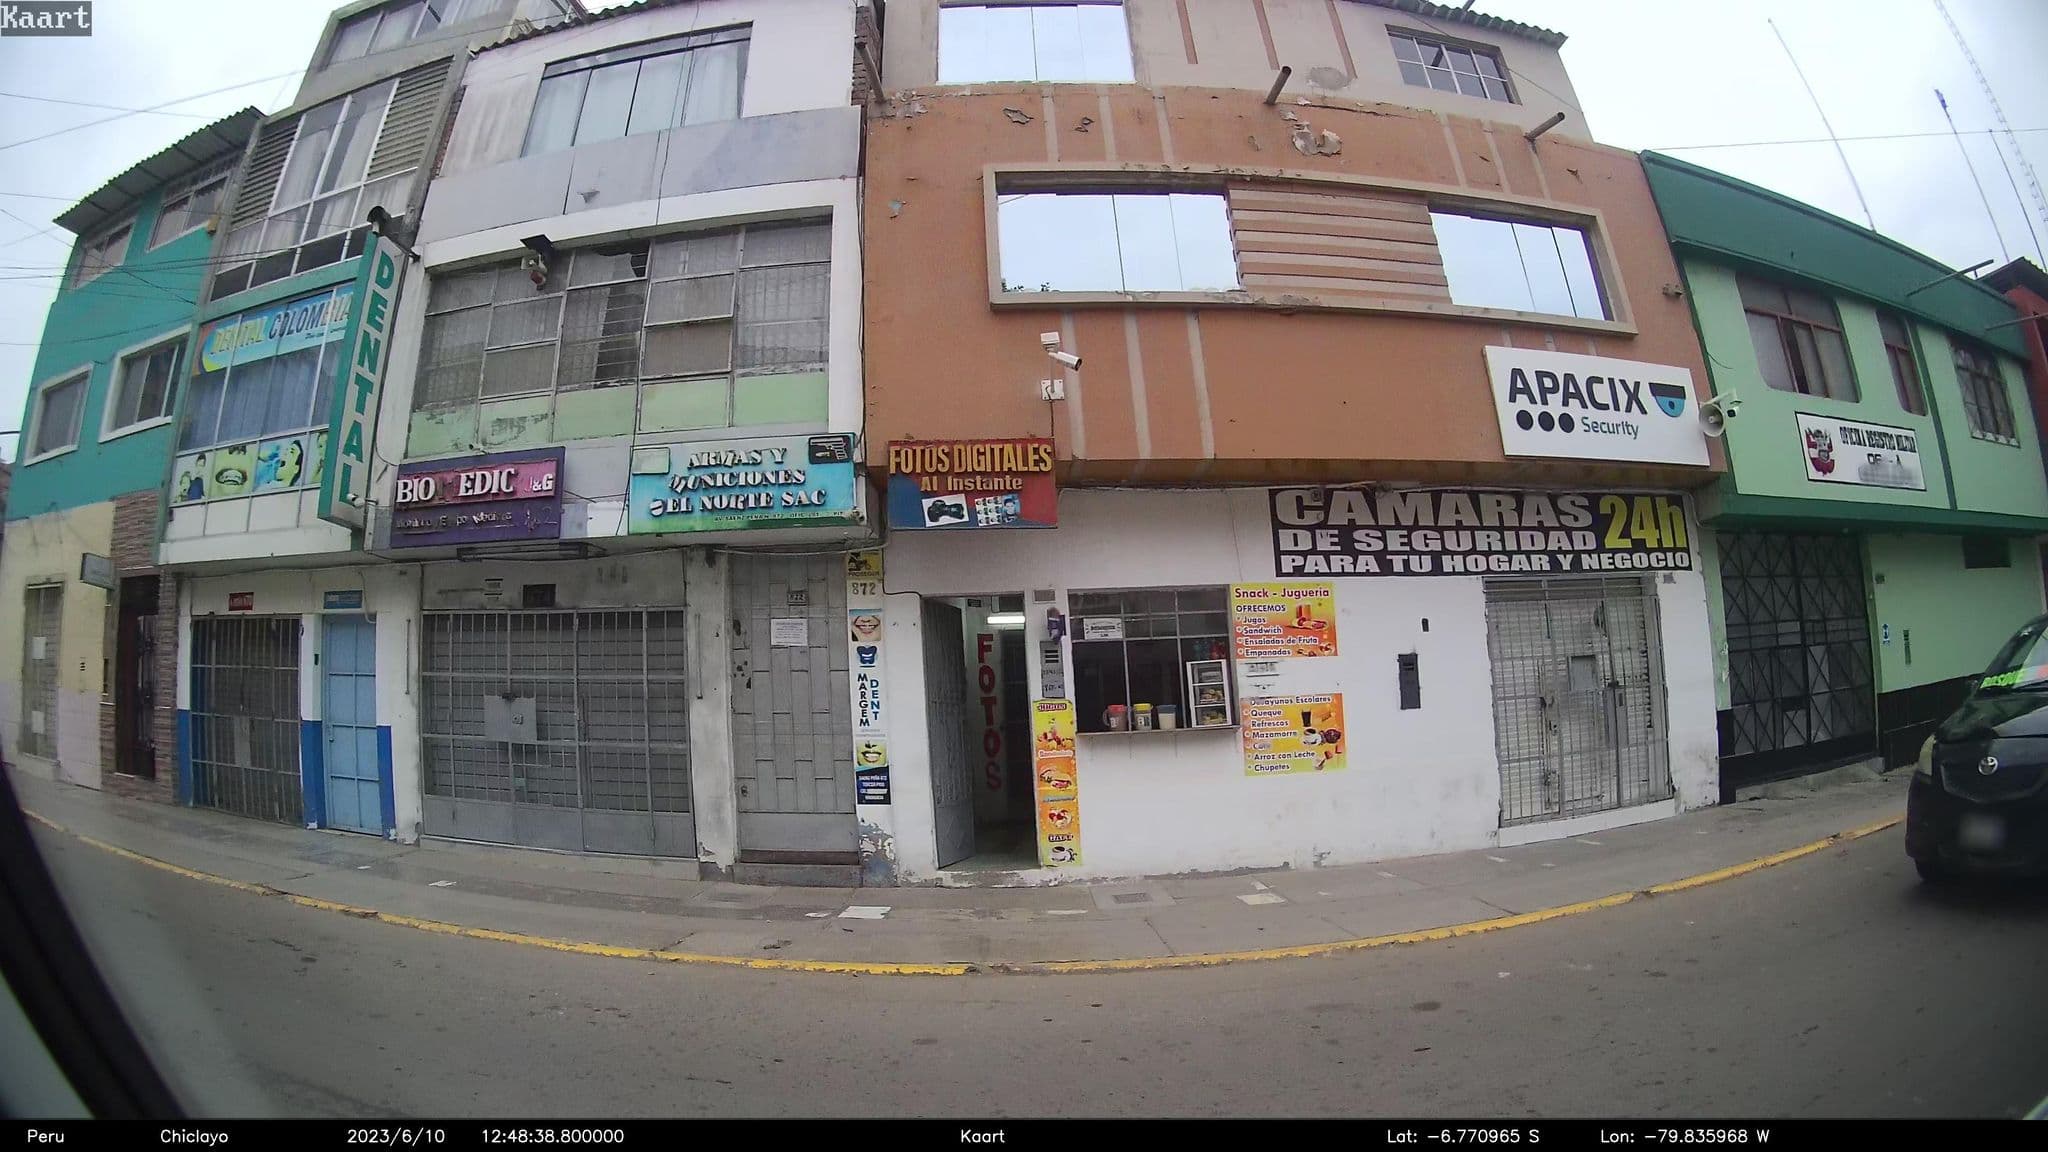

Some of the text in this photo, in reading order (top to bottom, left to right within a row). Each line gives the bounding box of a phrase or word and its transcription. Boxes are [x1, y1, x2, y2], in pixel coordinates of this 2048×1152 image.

[338, 250, 396, 507] DENTAL
[1508, 367, 1648, 415] APACIX
[1581, 416, 1639, 440] Security
[687, 447, 787, 471] ARMAS Y
[889, 443, 1054, 474] FOTOS DIGITALES
[668, 468, 806, 494] MUNICIONES
[947, 475, 1023, 491] Instante
[699, 491, 774, 512] NORTE
[781, 488, 827, 508] SAC
[1275, 489, 1688, 549] CAMARAS 24h
[1278, 529, 1597, 552] DE SEGURIDAD
[1280, 551, 1691, 573] PARA TU HOGAR Y NEGOCIO
[852, 582, 876, 596] 872
[1235, 588, 1269, 598] Snack
[1236, 604, 1286, 613] OFRECEMOS
[1243, 616, 1267, 625] Jugos
[1244, 626, 1282, 635] Sandwich
[1245, 635, 1319, 646] Ensaladas de Fruta
[1246, 648, 1291, 657] Empanadas
[857, 673, 870, 727] MARGEM
[870, 679, 880, 721] DENT
[1295, 696, 1331, 705] Escolares
[976, 633, 1002, 791] FOTOS
[1251, 709, 1282, 718] Queque
[1251, 720, 1289, 728] Refrescos
[1254, 753, 1276, 761] Arroz
[1294, 750, 1316, 759] Leche
[1254, 764, 1290, 773] Chupetes
